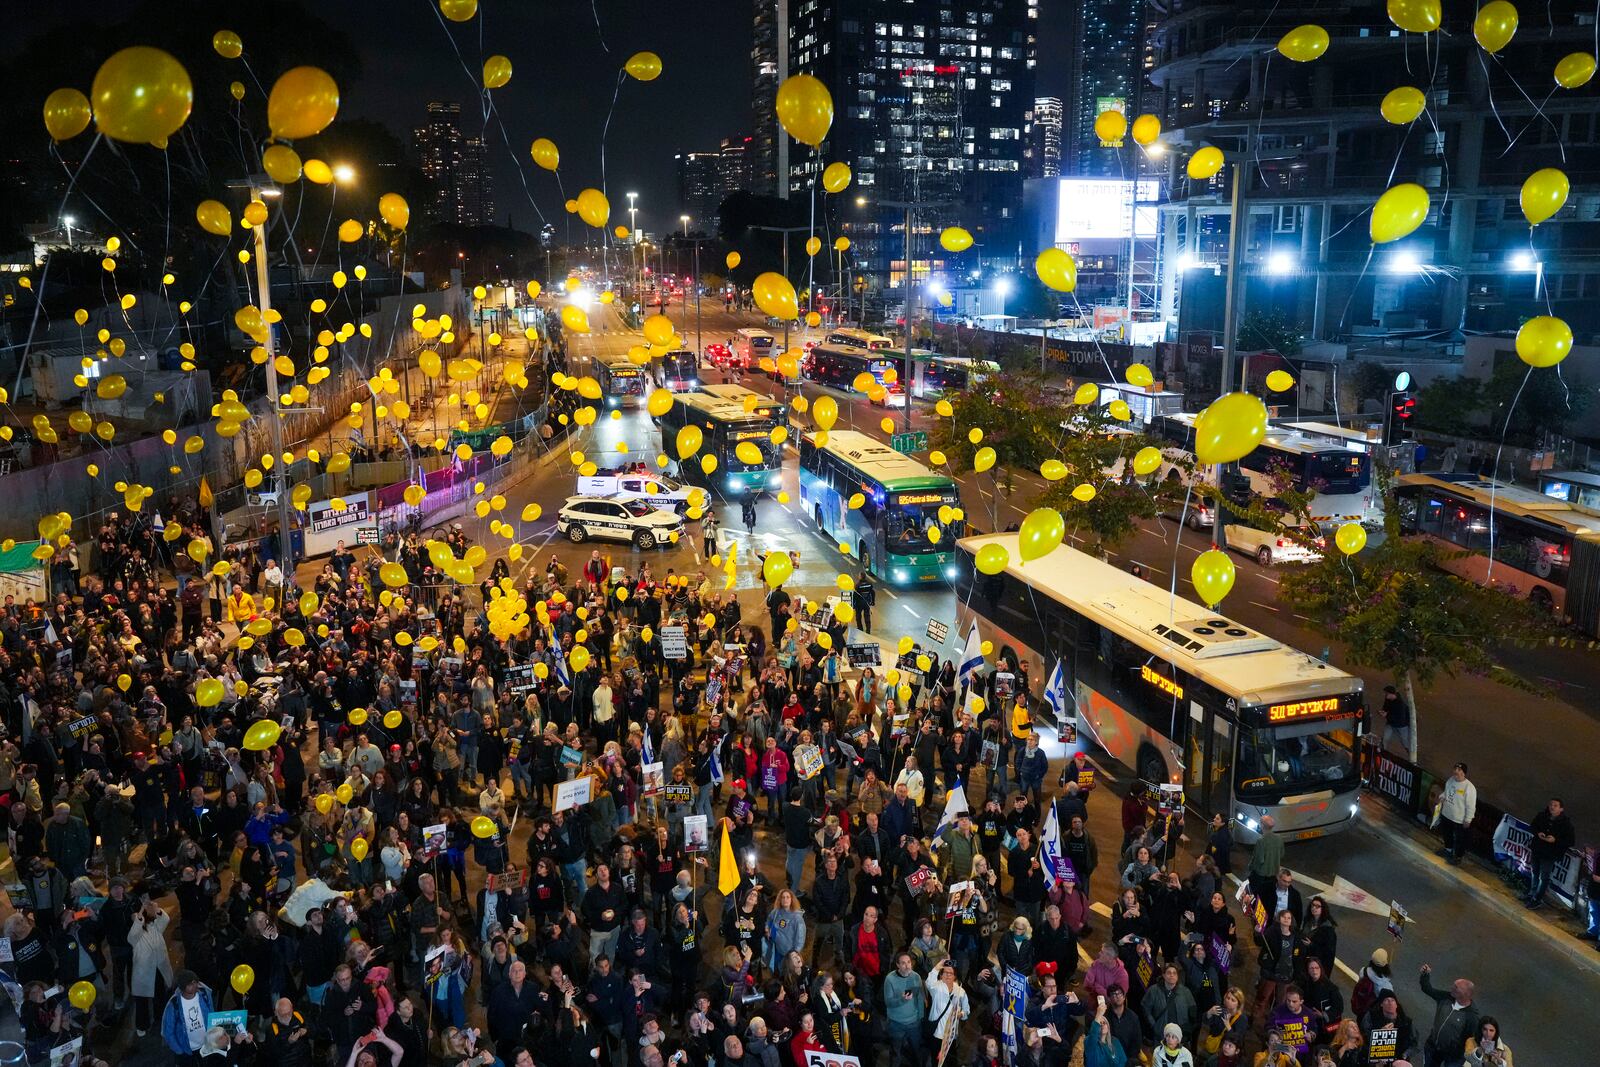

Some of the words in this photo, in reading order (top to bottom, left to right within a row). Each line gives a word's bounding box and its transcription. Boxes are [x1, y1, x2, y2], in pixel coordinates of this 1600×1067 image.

[909, 495, 926, 503] Central
[357, 511, 366, 520] עד
[1300, 700, 1324, 714] אביב
[1324, 698, 1338, 711] תל
[1380, 758, 1413, 788] מחזירים
[1399, 785, 1411, 805] את
[1372, 1030, 1397, 1039] הימים
